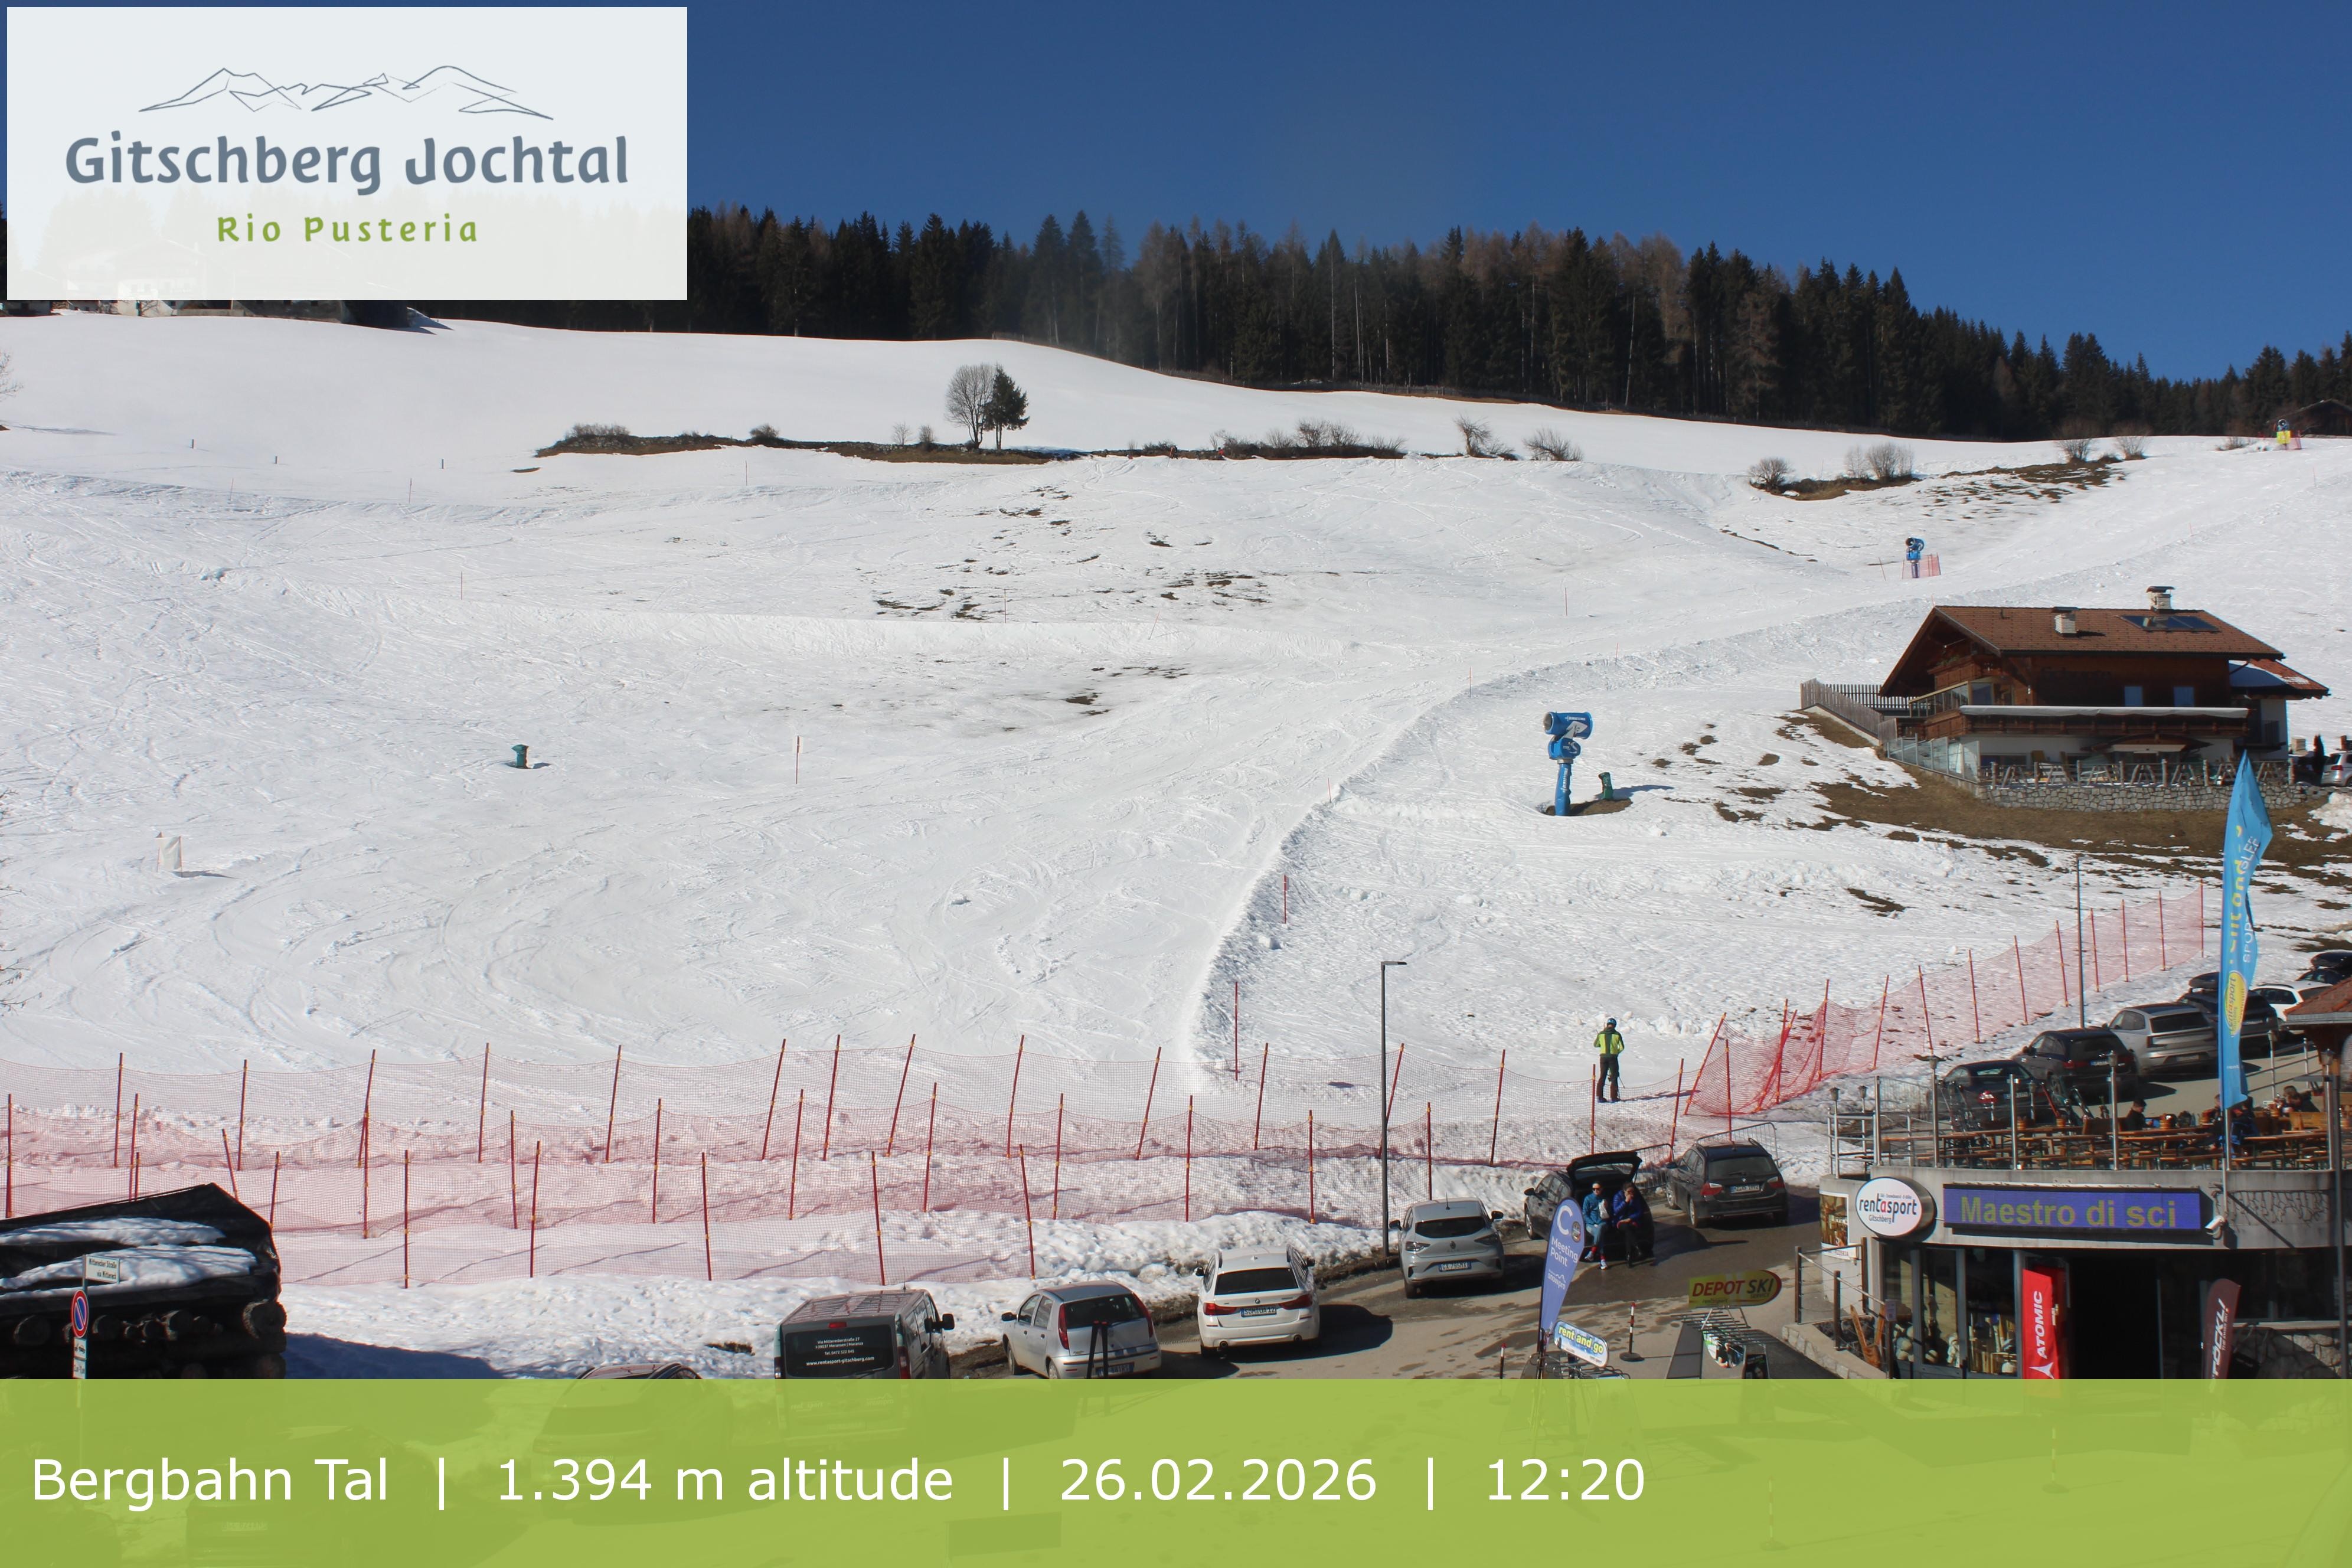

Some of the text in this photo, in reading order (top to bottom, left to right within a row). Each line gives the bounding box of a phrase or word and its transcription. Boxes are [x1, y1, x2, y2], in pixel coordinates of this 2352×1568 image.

[1859, 1193, 1917, 1223] rentasport
[1868, 1214, 1892, 1224] Gitschberg
[1961, 1196, 2176, 1227] Maestro di sci
[1550, 1247, 1567, 1267] Point
[1551, 1236, 1579, 1263] Meeting
[1692, 1278, 1774, 1297] DEPOT SKI
[2033, 1291, 2047, 1360] ATOMIC
[1559, 1325, 1604, 1355] rent and go
[806, 1357, 875, 1366] www.rentasport-gitschberg.com
